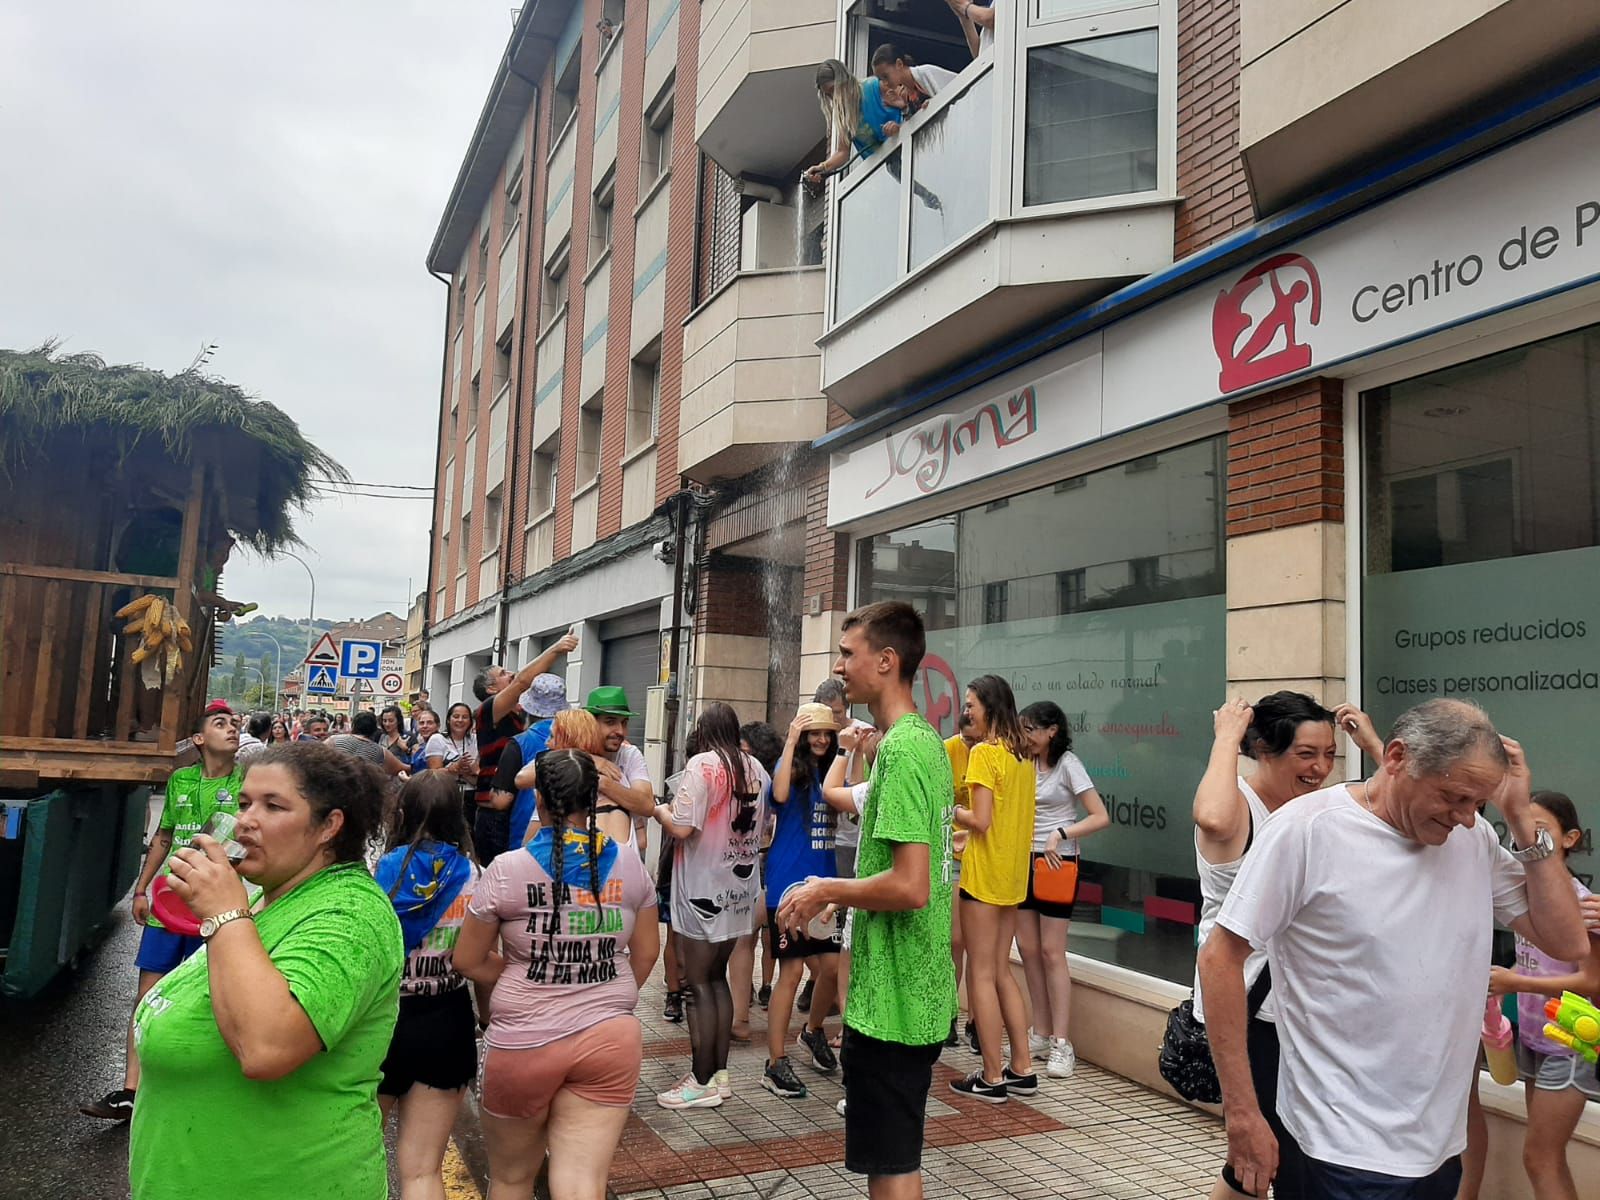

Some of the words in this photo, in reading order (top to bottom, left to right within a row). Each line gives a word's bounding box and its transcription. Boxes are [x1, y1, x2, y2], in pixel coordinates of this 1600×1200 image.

[1352, 254, 1483, 323] Centro
[1499, 225, 1560, 271] de
[1395, 628, 1466, 651] Grupos
[1473, 617, 1587, 644] reducidos
[349, 643, 376, 674] P
[1011, 671, 1027, 691] lud
[1047, 681, 1062, 690] un
[1066, 671, 1104, 690] estado
[1376, 676, 1437, 695] Clases
[1443, 669, 1600, 696] personalizada
[1098, 793, 1167, 831] ilates
[526, 883, 547, 908] DE
[526, 912, 537, 933] A
[530, 940, 550, 961] LA
[558, 940, 592, 963] VIDA
[598, 937, 617, 960] NO
[526, 960, 548, 983] DA
[552, 965, 572, 984] PA
[578, 960, 618, 984] NADA
